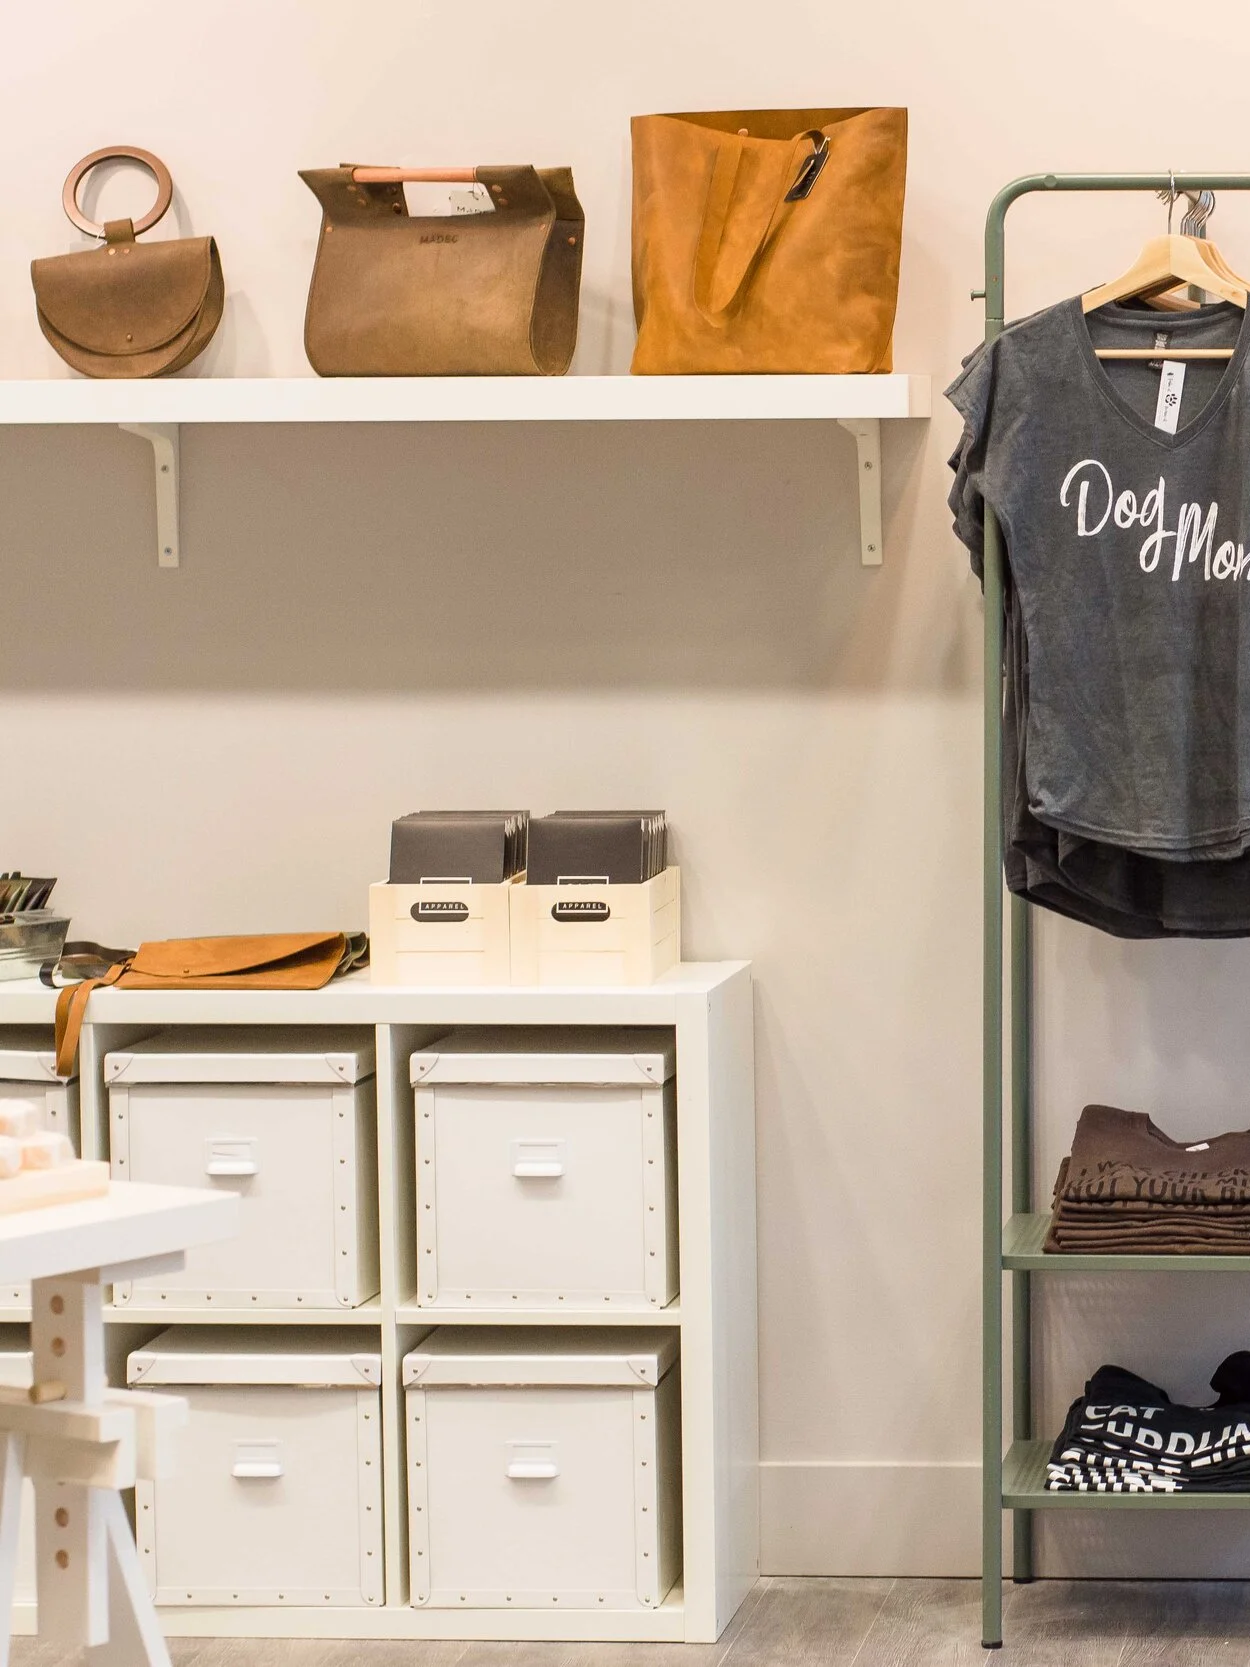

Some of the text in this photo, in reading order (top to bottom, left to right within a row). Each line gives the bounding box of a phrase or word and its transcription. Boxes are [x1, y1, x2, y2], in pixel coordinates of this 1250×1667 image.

[1060, 459, 1177, 573] Dog
[425, 902, 464, 910] APPAREL
[562, 902, 602, 910] APPAREL
[1085, 1405, 1165, 1420] CAT
